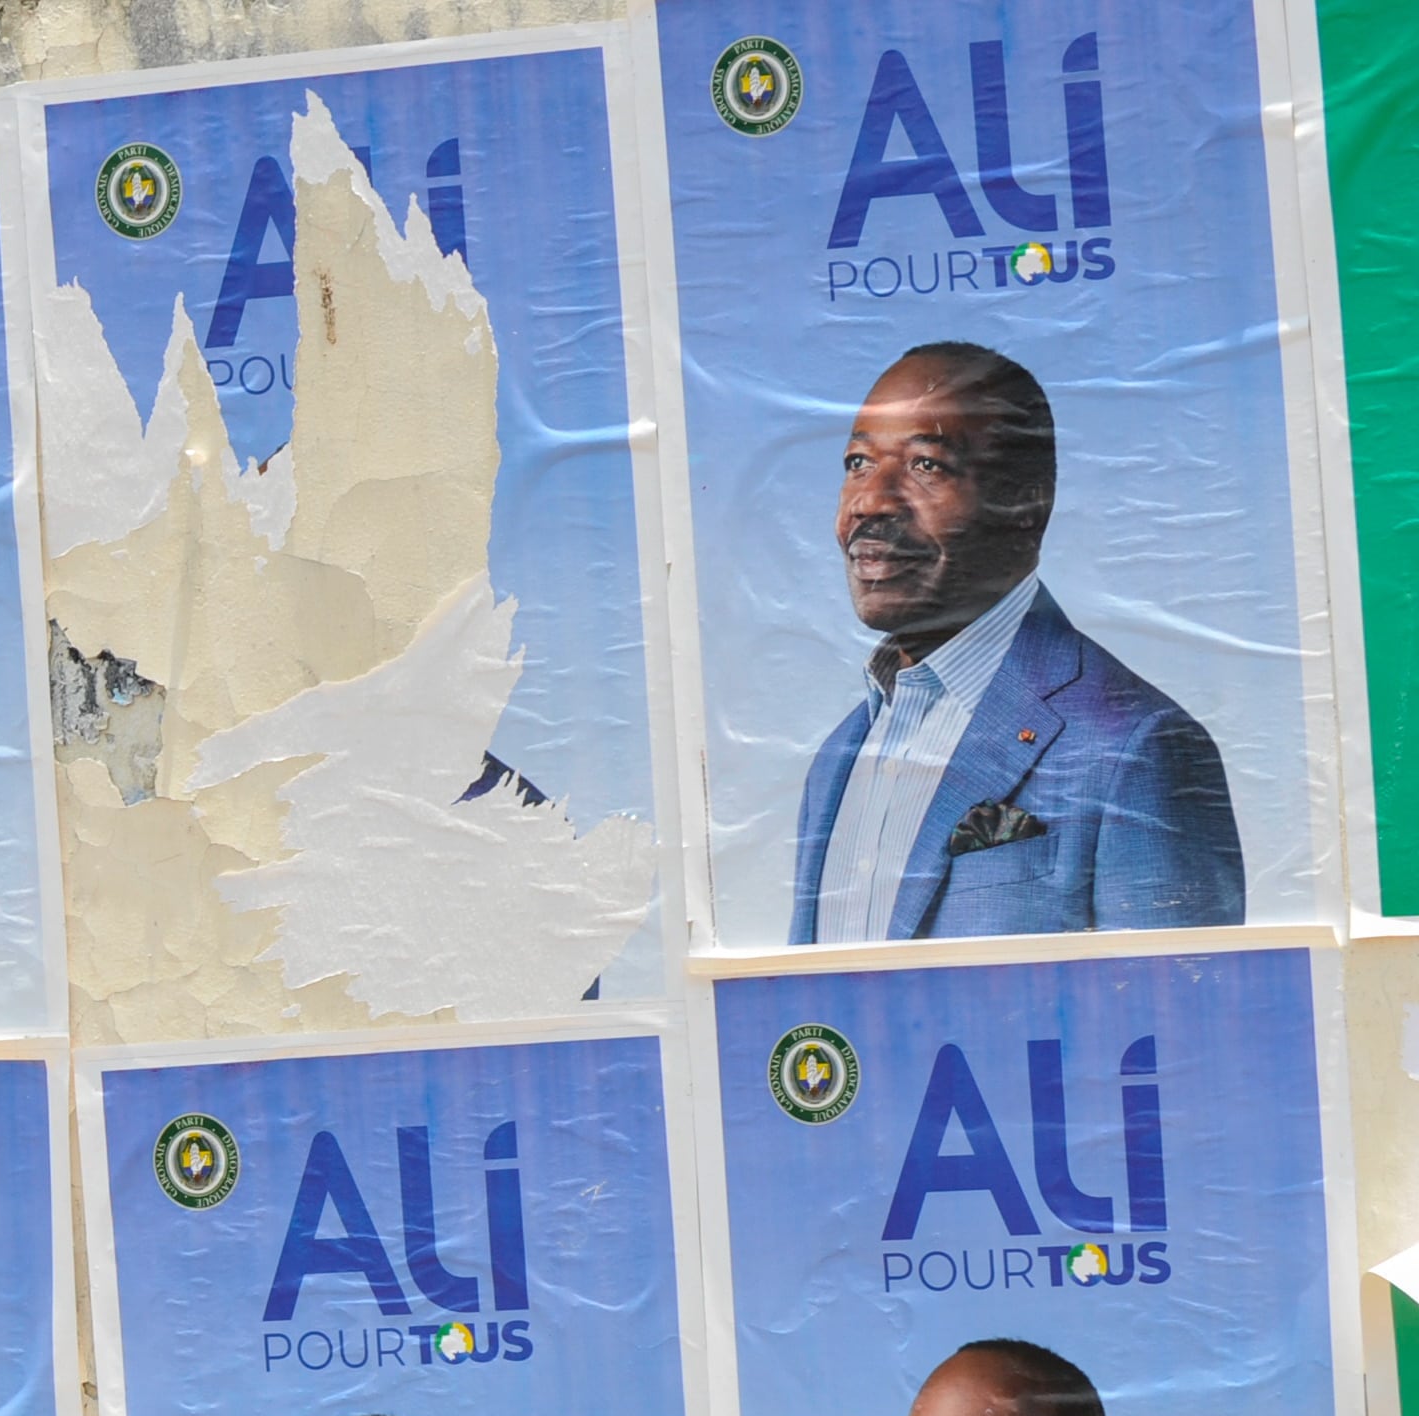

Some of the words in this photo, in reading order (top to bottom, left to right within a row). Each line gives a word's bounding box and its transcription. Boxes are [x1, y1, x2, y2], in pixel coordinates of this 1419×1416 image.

[734, 40, 764, 54] PARTI
[118, 146, 147, 160] PARTI
[791, 1028, 823, 1041] PARTI
[175, 1117, 204, 1130] PARTI
